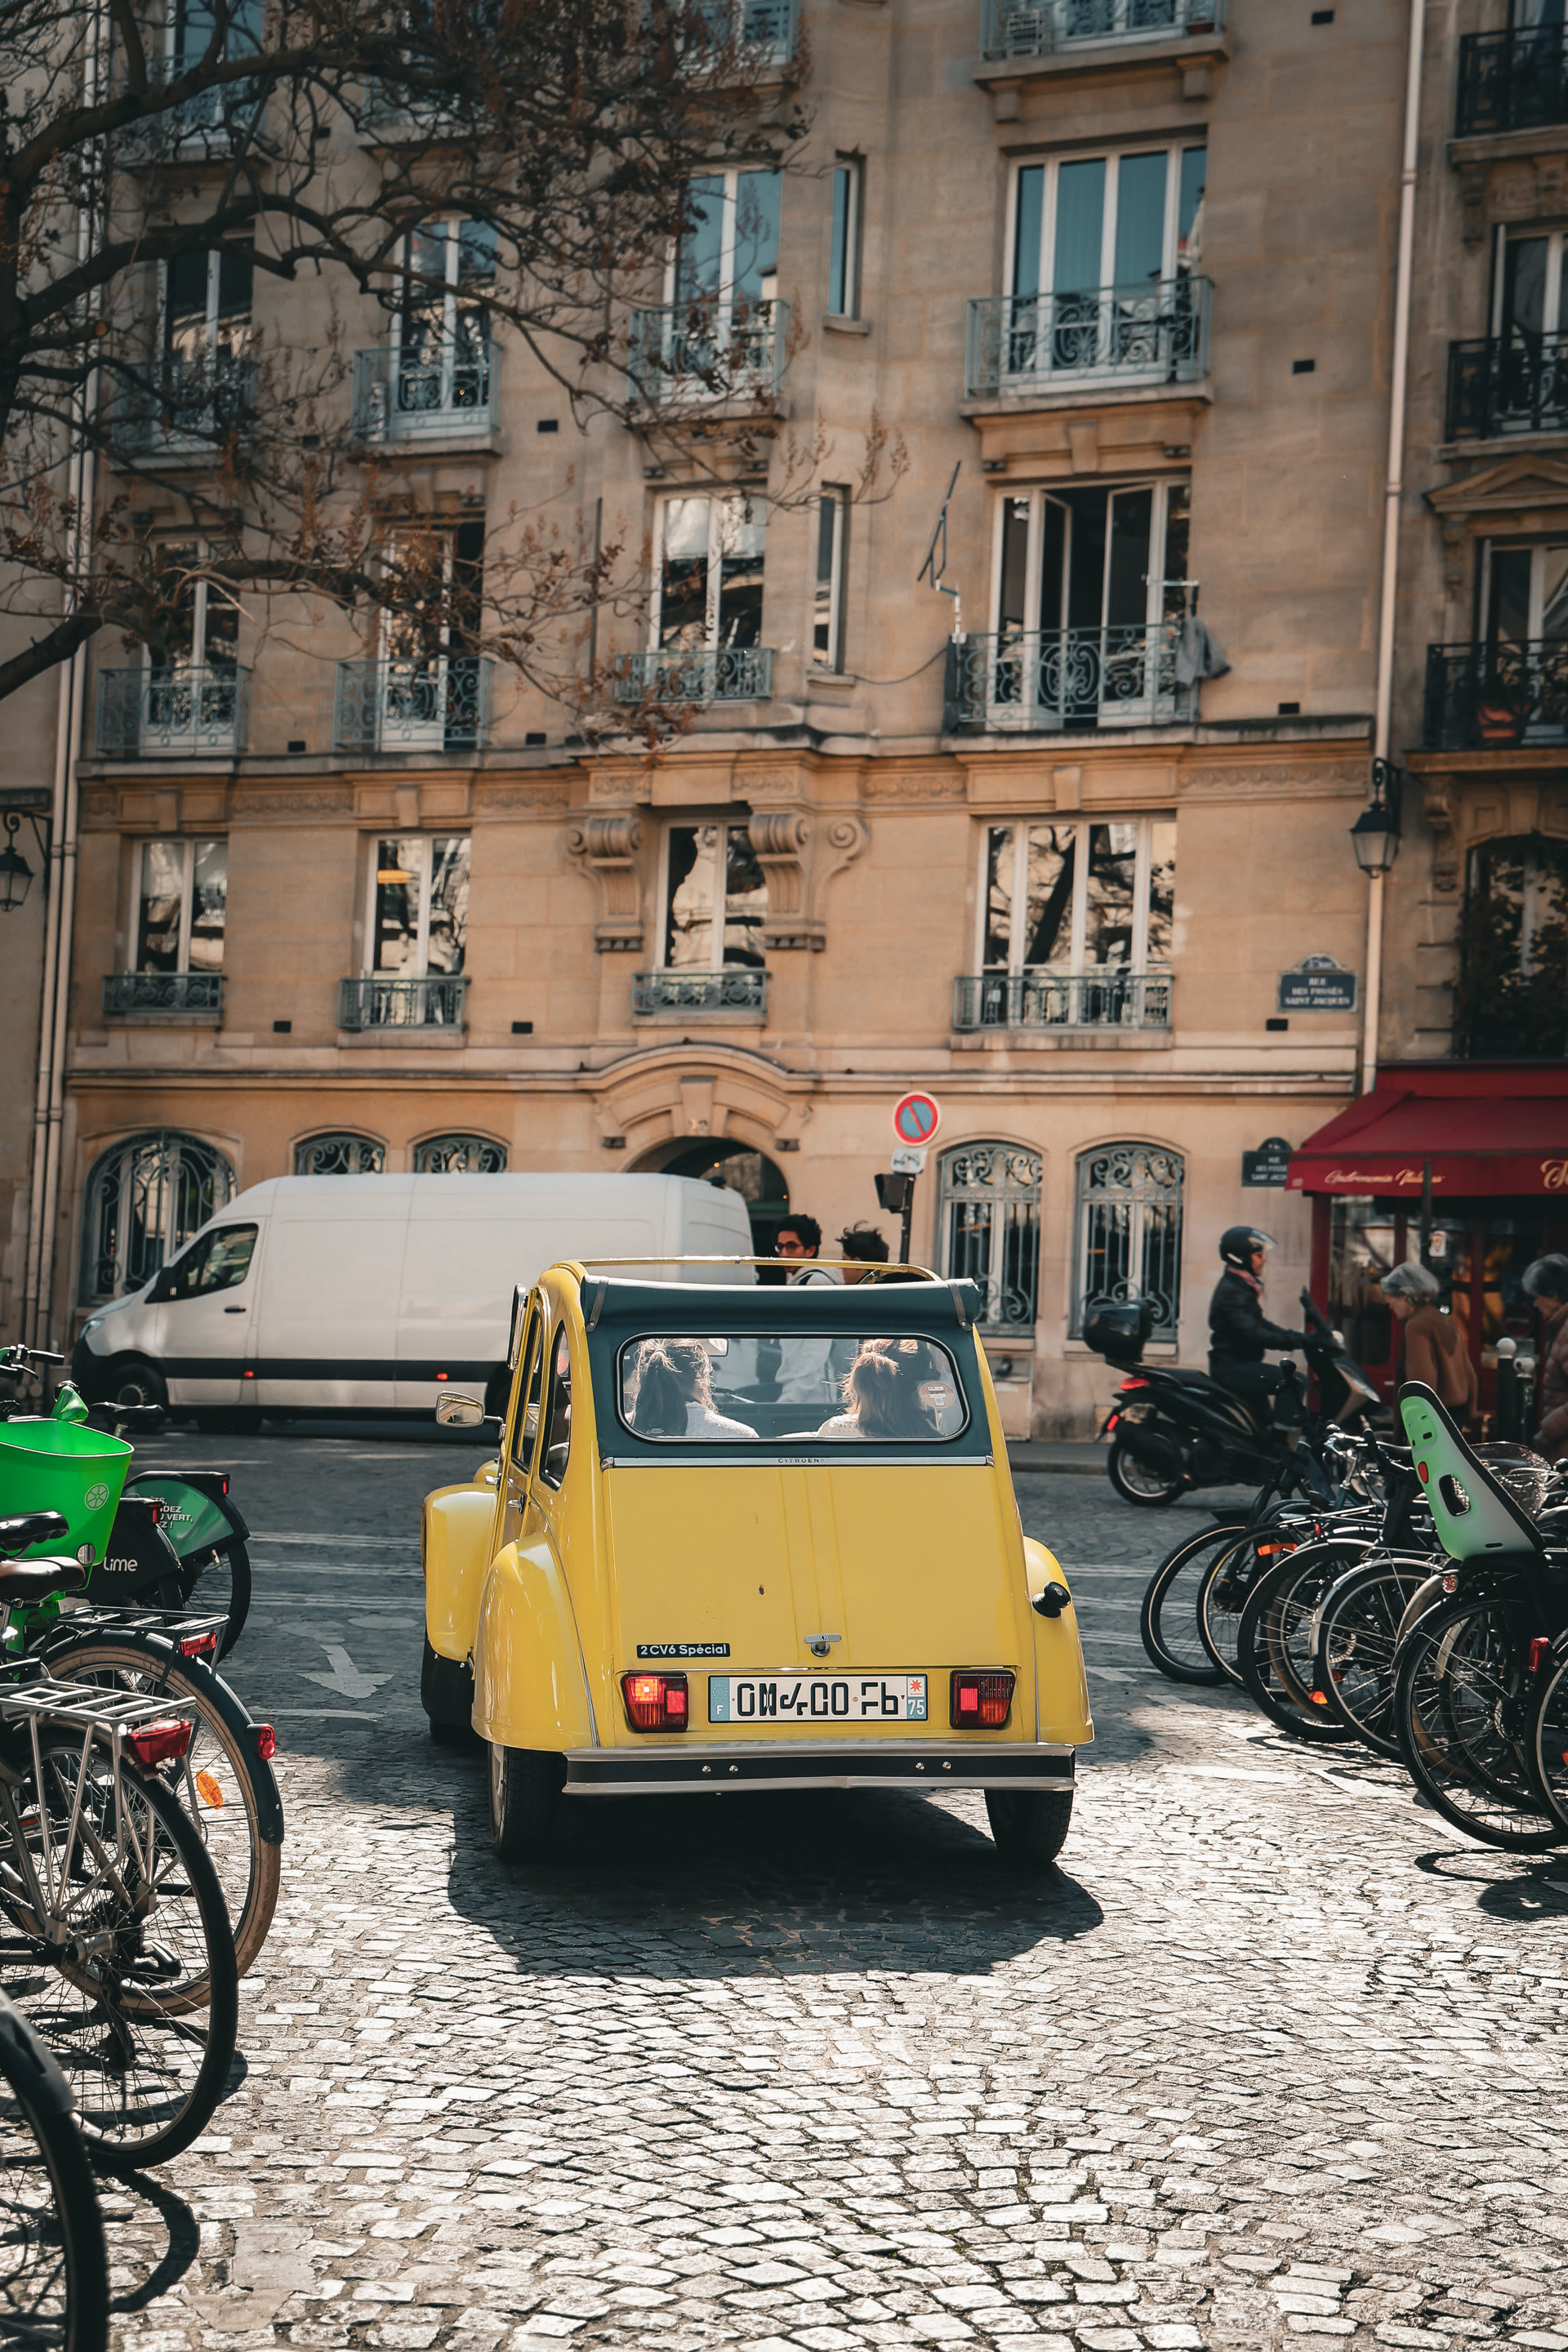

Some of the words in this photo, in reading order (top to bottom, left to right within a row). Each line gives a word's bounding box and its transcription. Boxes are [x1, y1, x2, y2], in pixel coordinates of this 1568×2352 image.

[1308, 978, 1326, 986] RUE
[1291, 987, 1308, 996] DES
[1395, 1169, 1443, 1187] Italna
[167, 1513, 194, 1523] VERT,
[104, 1557, 138, 1572] Lime
[679, 1643, 727, 1657] Spécial
[907, 1699, 925, 1716] 75
